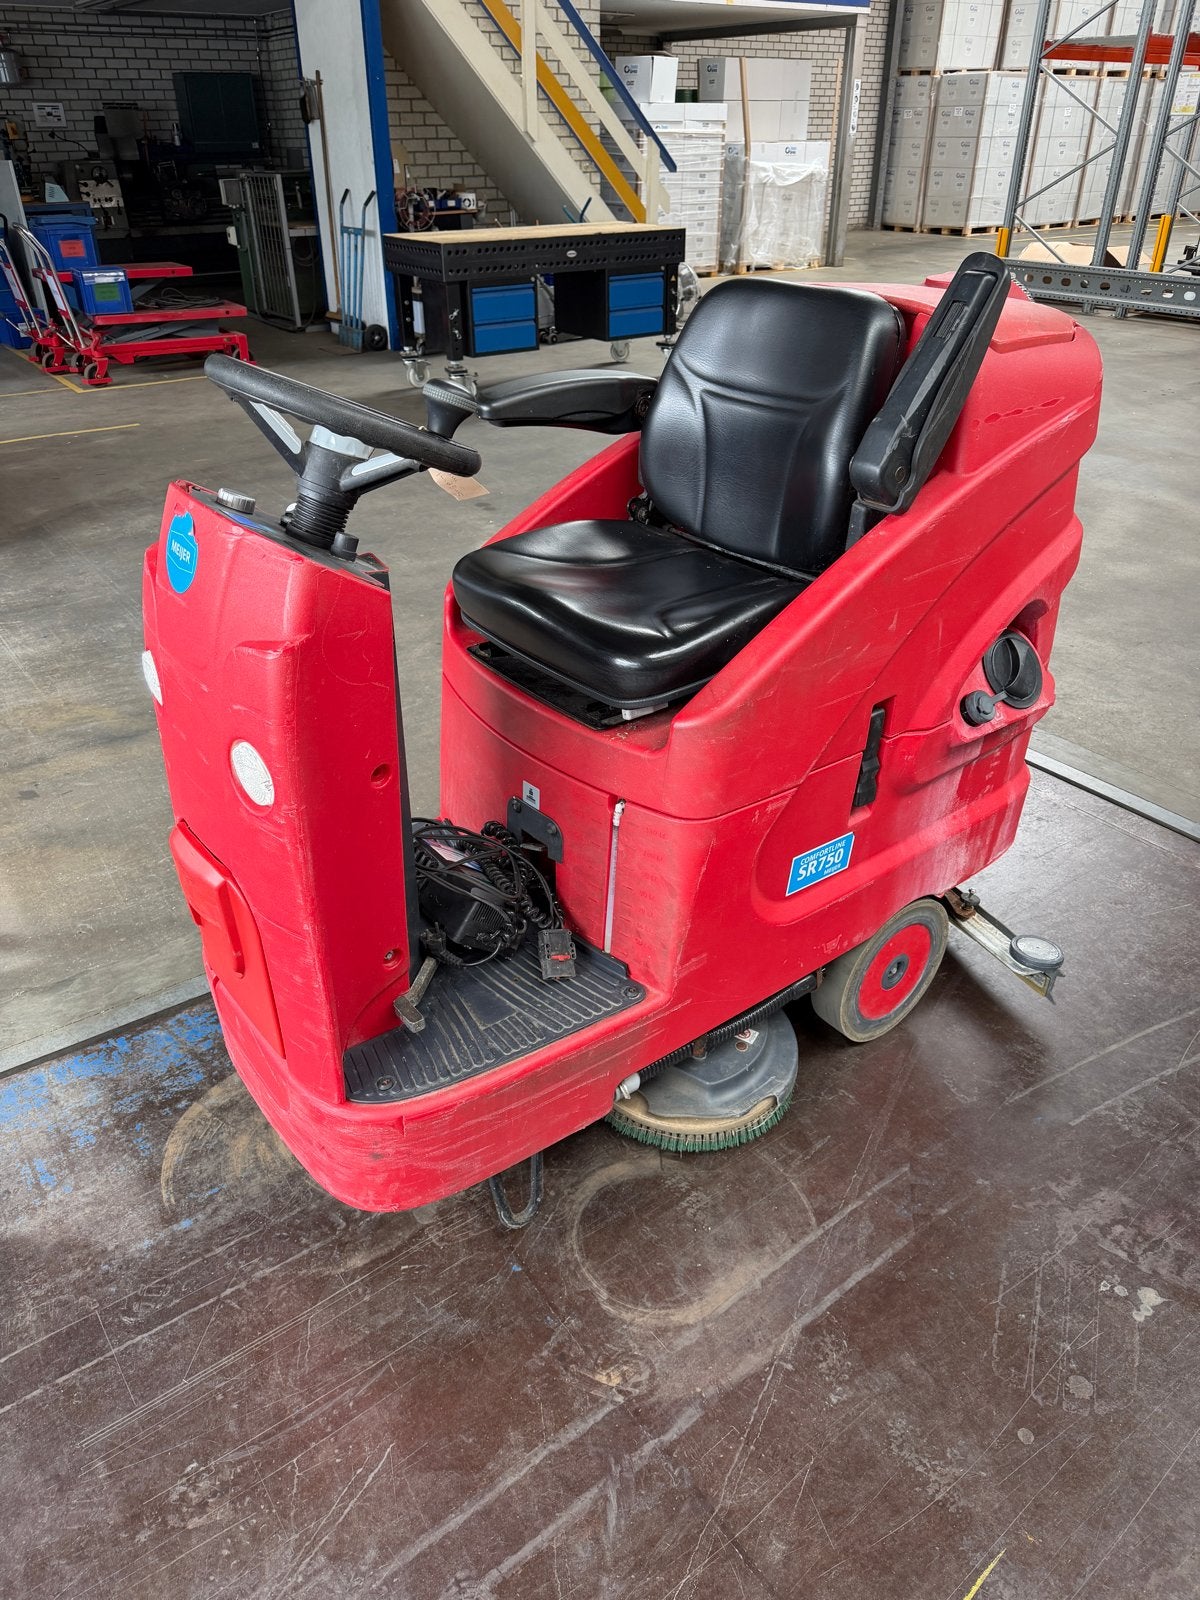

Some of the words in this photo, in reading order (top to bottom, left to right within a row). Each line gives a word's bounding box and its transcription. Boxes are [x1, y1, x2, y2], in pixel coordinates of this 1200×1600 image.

[171, 539, 191, 565] MEIJER
[797, 848, 843, 881] SR750
[800, 839, 846, 865] COMFORTLINE
